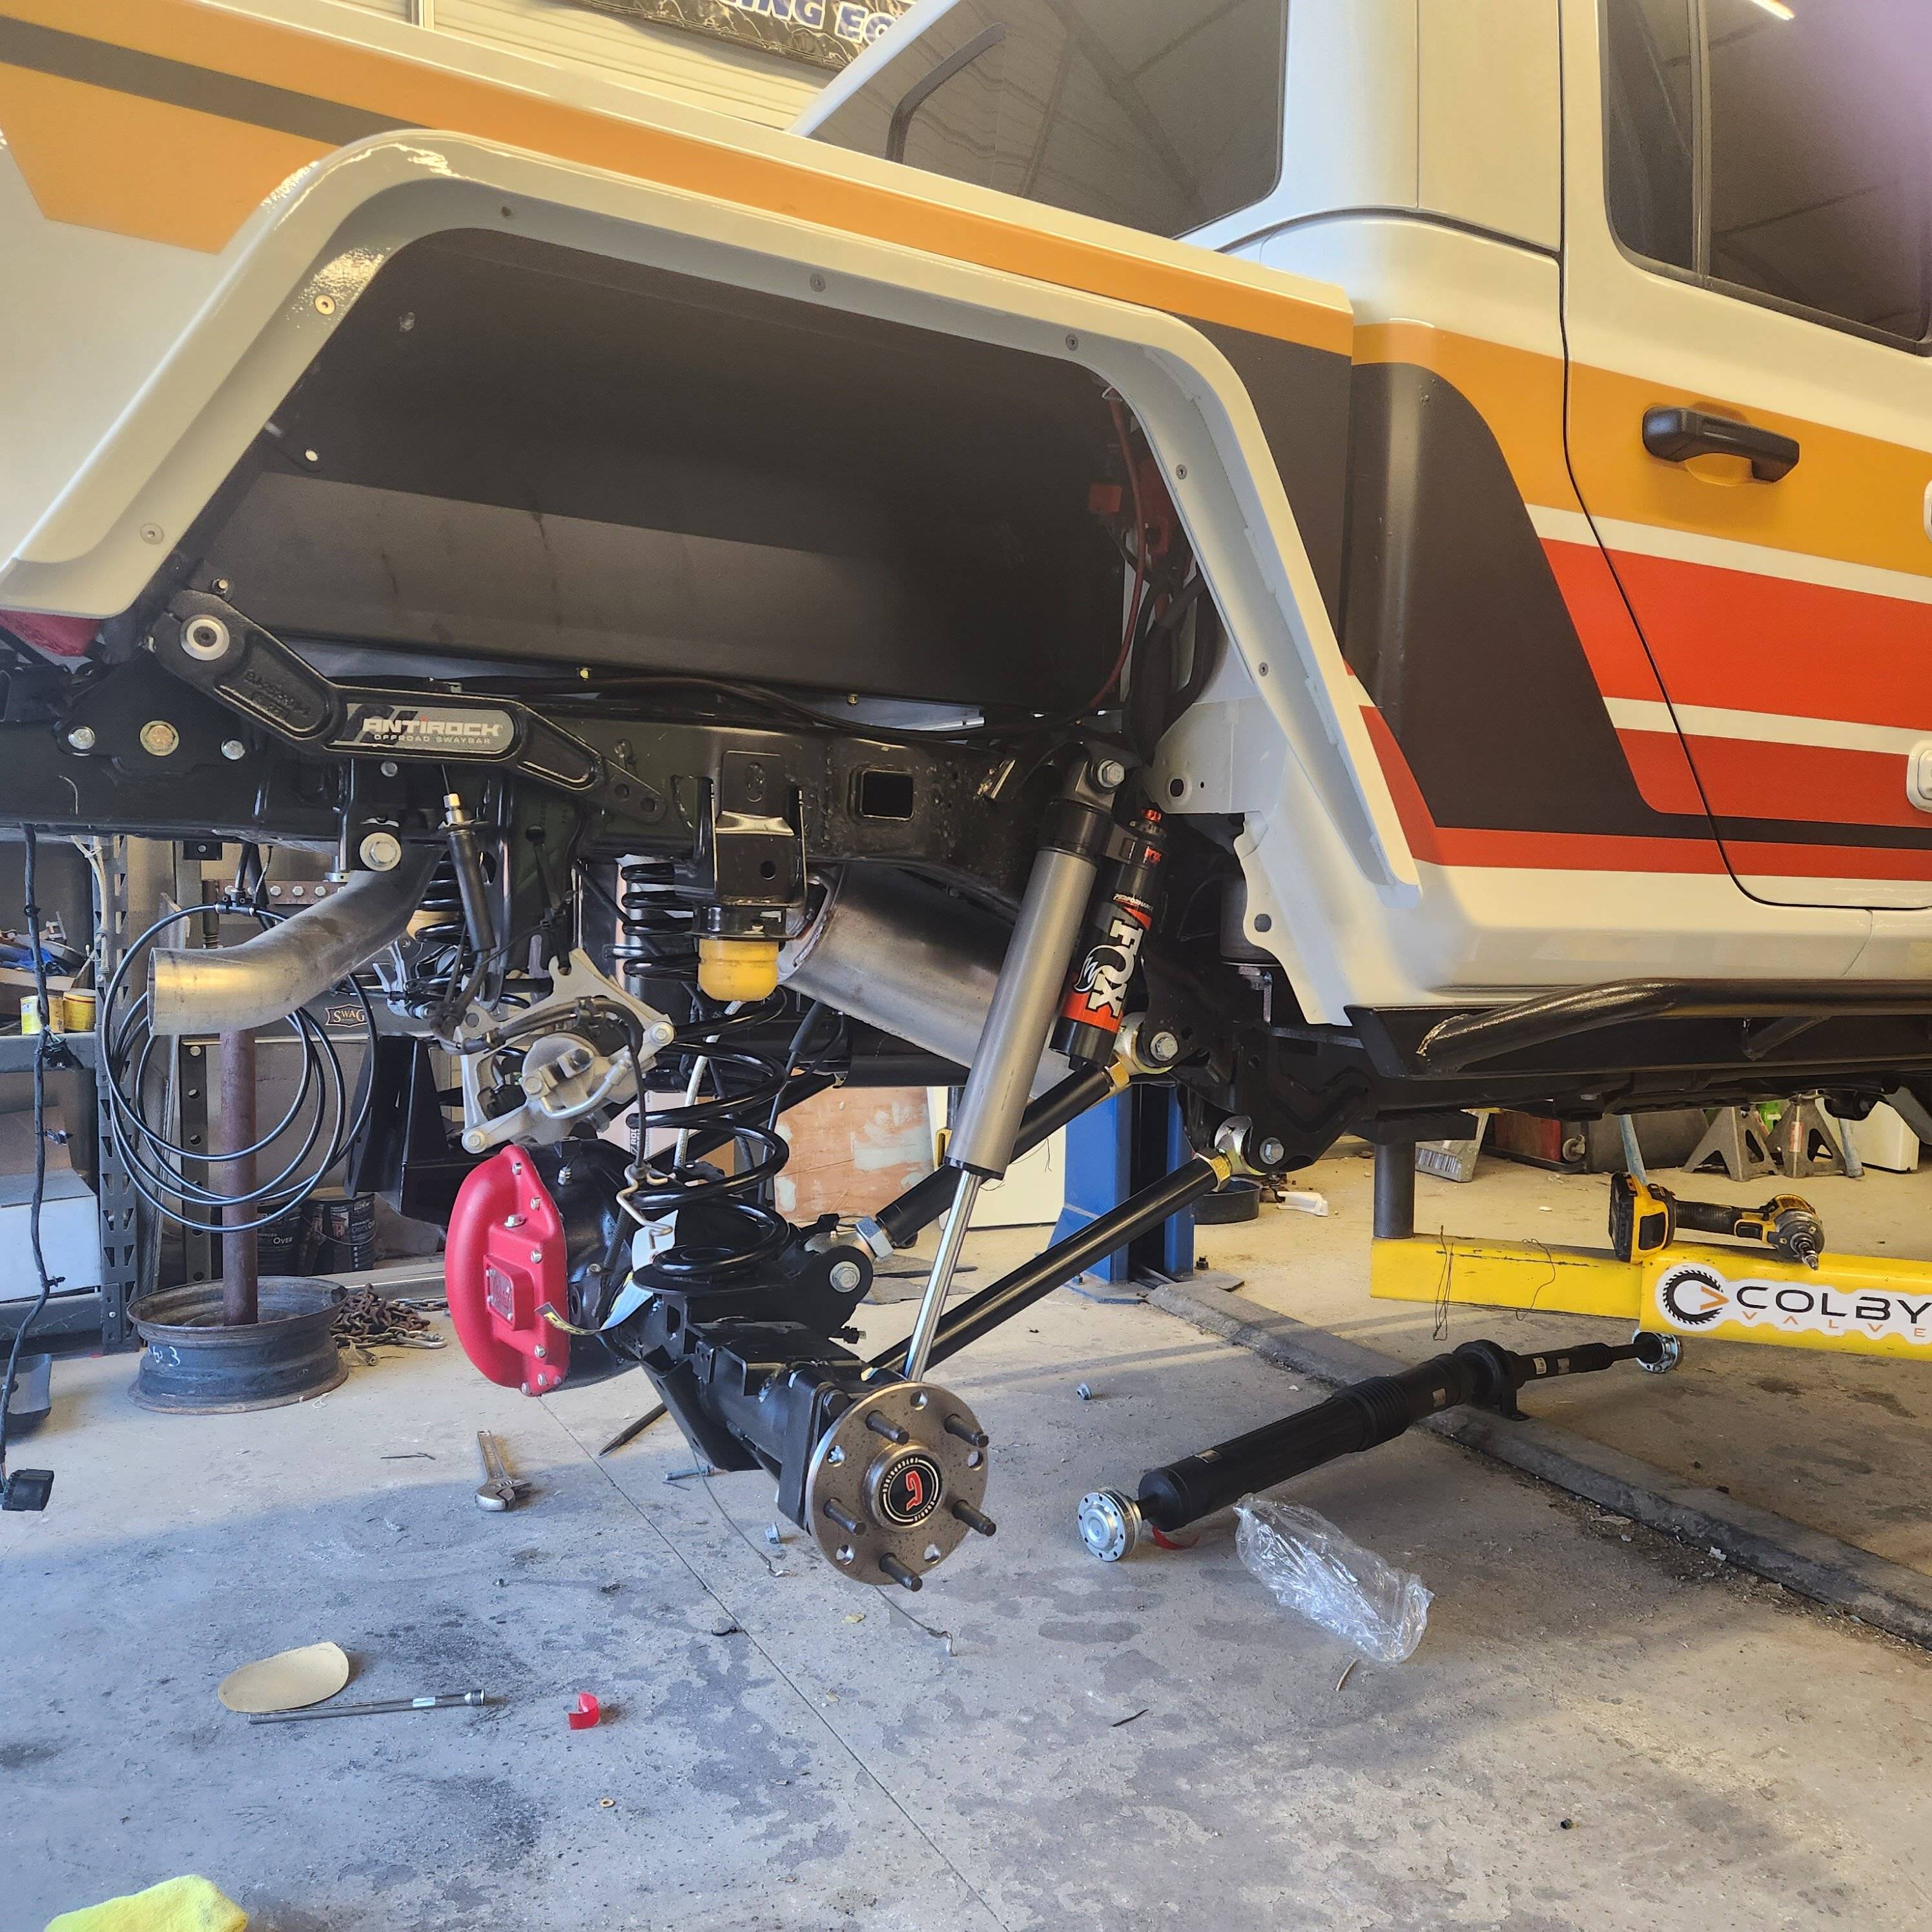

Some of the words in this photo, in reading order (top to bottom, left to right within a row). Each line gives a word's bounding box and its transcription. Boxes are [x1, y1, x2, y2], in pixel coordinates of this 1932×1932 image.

[374, 734, 431, 742] OFFROAD
[435, 735, 491, 744] SWAYBAR
[1074, 919, 1144, 1018] FOX
[333, 1009, 365, 1023] SWAG
[1736, 1286, 1932, 1324] COLBY
[1742, 1311, 1927, 1338] VALVE
